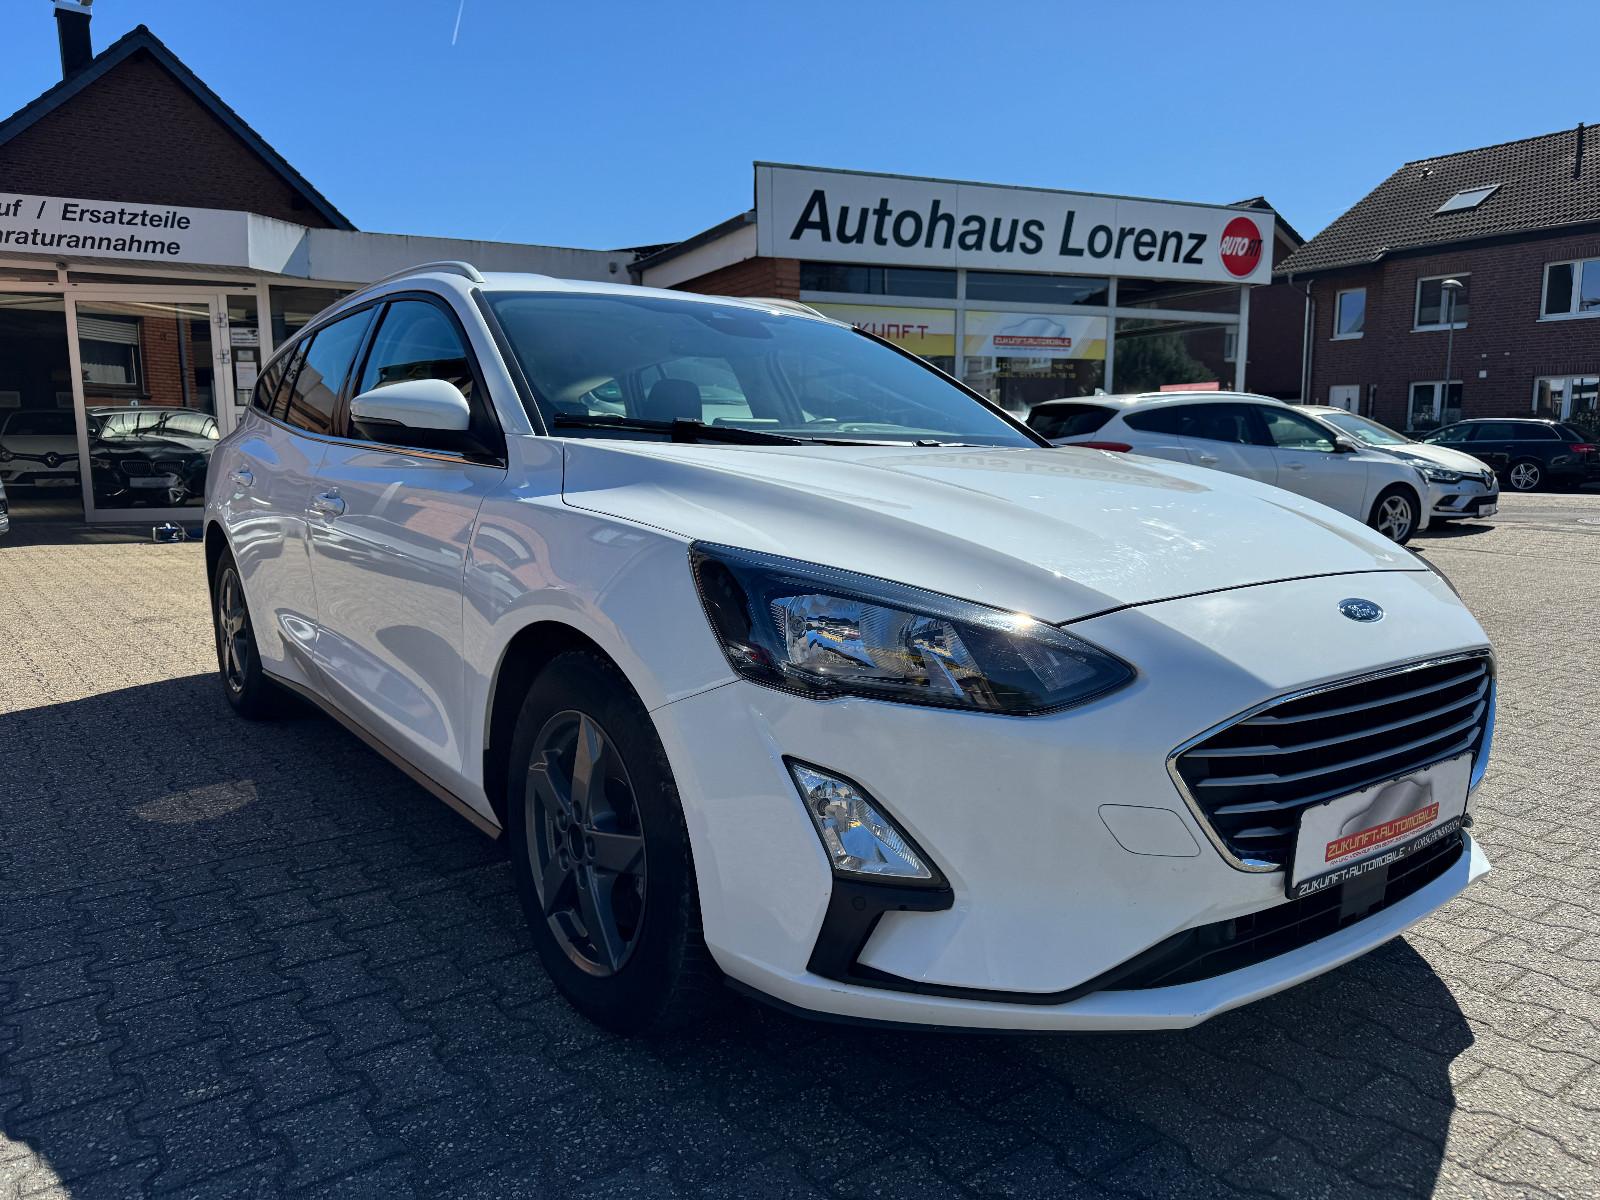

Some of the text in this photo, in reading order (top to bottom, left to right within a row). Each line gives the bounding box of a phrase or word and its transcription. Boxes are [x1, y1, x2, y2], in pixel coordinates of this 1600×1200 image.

[61, 202, 191, 230] Ersatzteile
[789, 189, 1207, 265] Autohaus Lorenz
[0, 228, 181, 255] raturannahme
[1326, 806, 1438, 859] ZUKUNFT.AUTOMOBILE
[1299, 847, 1405, 896] ZUKUNFT.AUTOMOBILE
